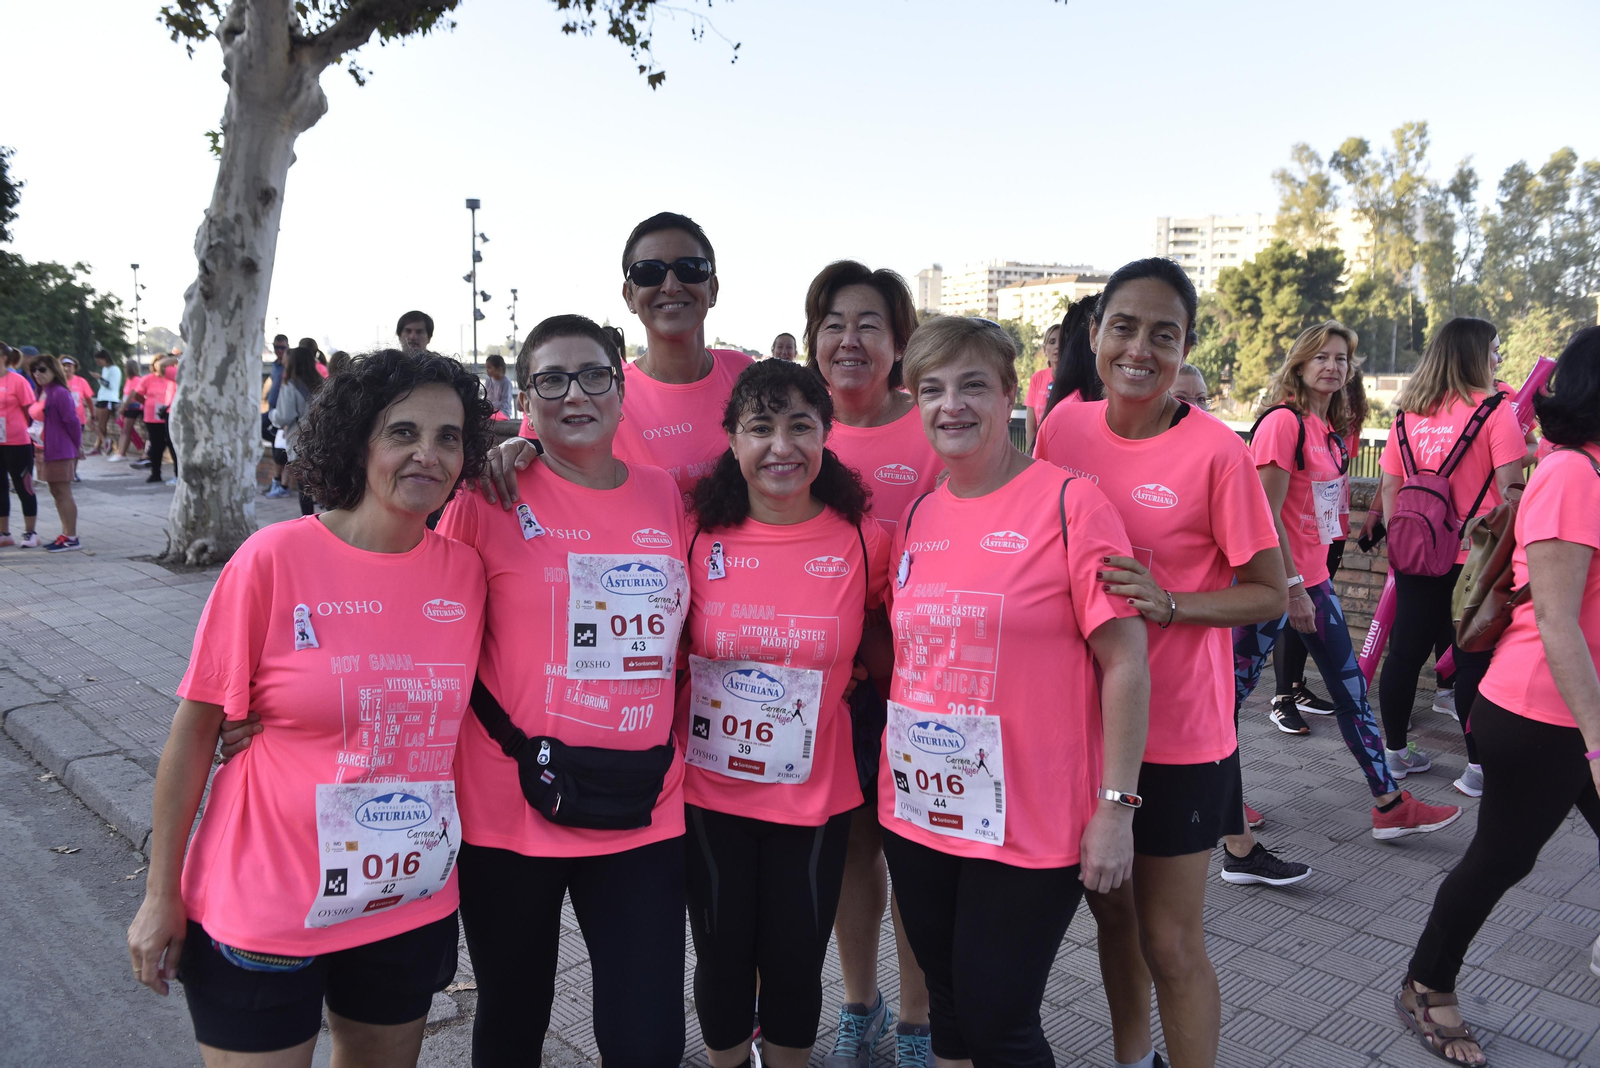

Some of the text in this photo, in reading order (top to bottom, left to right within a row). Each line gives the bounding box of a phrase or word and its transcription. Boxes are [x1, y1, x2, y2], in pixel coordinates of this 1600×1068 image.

[643, 422, 693, 440] OYSHO
[877, 469, 915, 481] ASTURIANA
[1135, 489, 1174, 505] ASTURIANA
[545, 527, 591, 541] YSHO
[909, 539, 950, 553] OYSHO
[704, 555, 760, 569] OSHO
[605, 575, 664, 587] ASTURIANA
[648, 594, 671, 604] Carrera
[317, 599, 383, 617] OYSHO
[703, 600, 775, 620] HOY GANAN
[916, 604, 986, 618] VITORIA GASTEIZ
[611, 613, 665, 637] 016
[930, 615, 961, 627] MADRID
[742, 626, 826, 640] VITORIA GASTEIZ
[1360, 619, 1380, 659] Ladival
[631, 641, 646, 652] 43
[761, 636, 799, 649] MADRID
[331, 653, 414, 674] HOY GANAN
[575, 660, 610, 669] OYSHO
[387, 679, 460, 690] VITORIA GASTEIZ
[726, 676, 779, 697] ASTURIANA
[933, 670, 990, 697] CHICAS
[408, 690, 443, 702] MADRID
[761, 703, 786, 713] Carrera
[618, 703, 654, 732] 2019
[722, 715, 774, 743] 016
[405, 733, 425, 747] LAS
[911, 730, 960, 748] ASTURIANA
[738, 743, 751, 755] 39
[338, 752, 385, 768] BARCELONA
[692, 747, 718, 762] OYSHO
[738, 762, 760, 771] Santander
[946, 755, 971, 765] Carrera
[915, 769, 964, 795] 016
[933, 797, 947, 809] 44
[361, 807, 426, 822] ASTURIANA
[901, 801, 922, 816] OYSHO
[937, 817, 958, 825] Santander
[407, 829, 435, 839] Carrera
[975, 828, 995, 837] ZURICH
[362, 851, 421, 880] 016
[381, 883, 396, 894] 42
[318, 907, 354, 917] OYSHO
